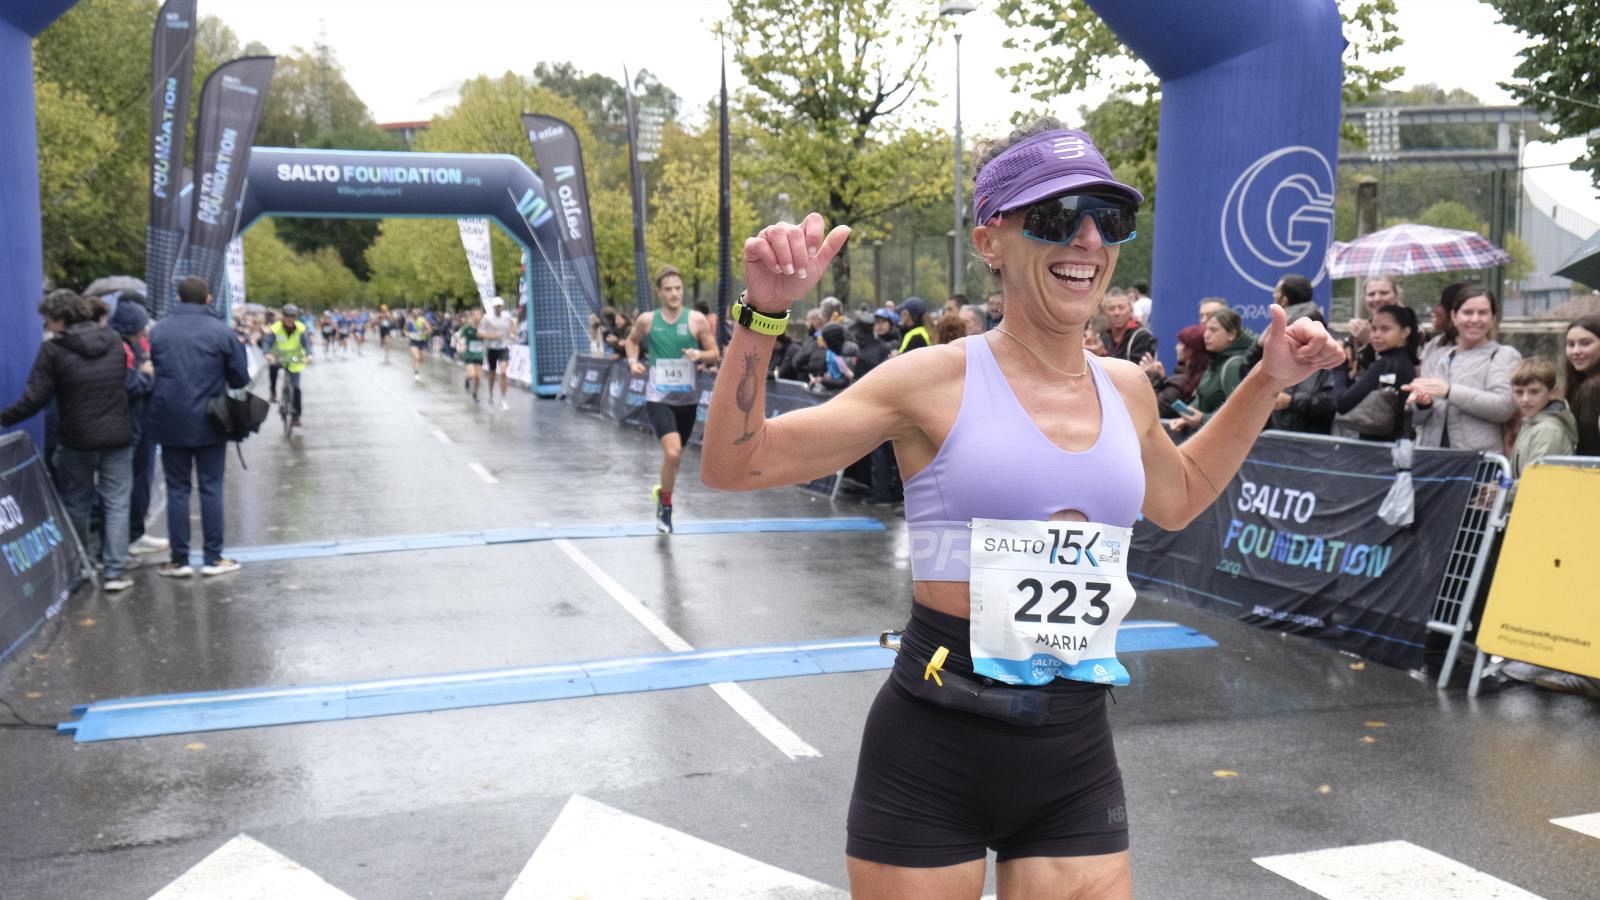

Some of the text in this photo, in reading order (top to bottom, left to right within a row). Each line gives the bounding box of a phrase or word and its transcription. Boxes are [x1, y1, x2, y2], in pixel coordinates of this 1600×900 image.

[153, 77, 177, 198] FOUNDATION
[210, 127, 238, 225] FOUNDATION
[277, 163, 340, 183] SALTO
[343, 165, 462, 185] FOUNDATION
[1237, 481, 1316, 524] SALTO
[984, 528, 1101, 567] SALTO 15K
[1223, 519, 1393, 578] FOUNDATION
[1014, 577, 1112, 627] 223
[1035, 632, 1088, 651] MARIA
